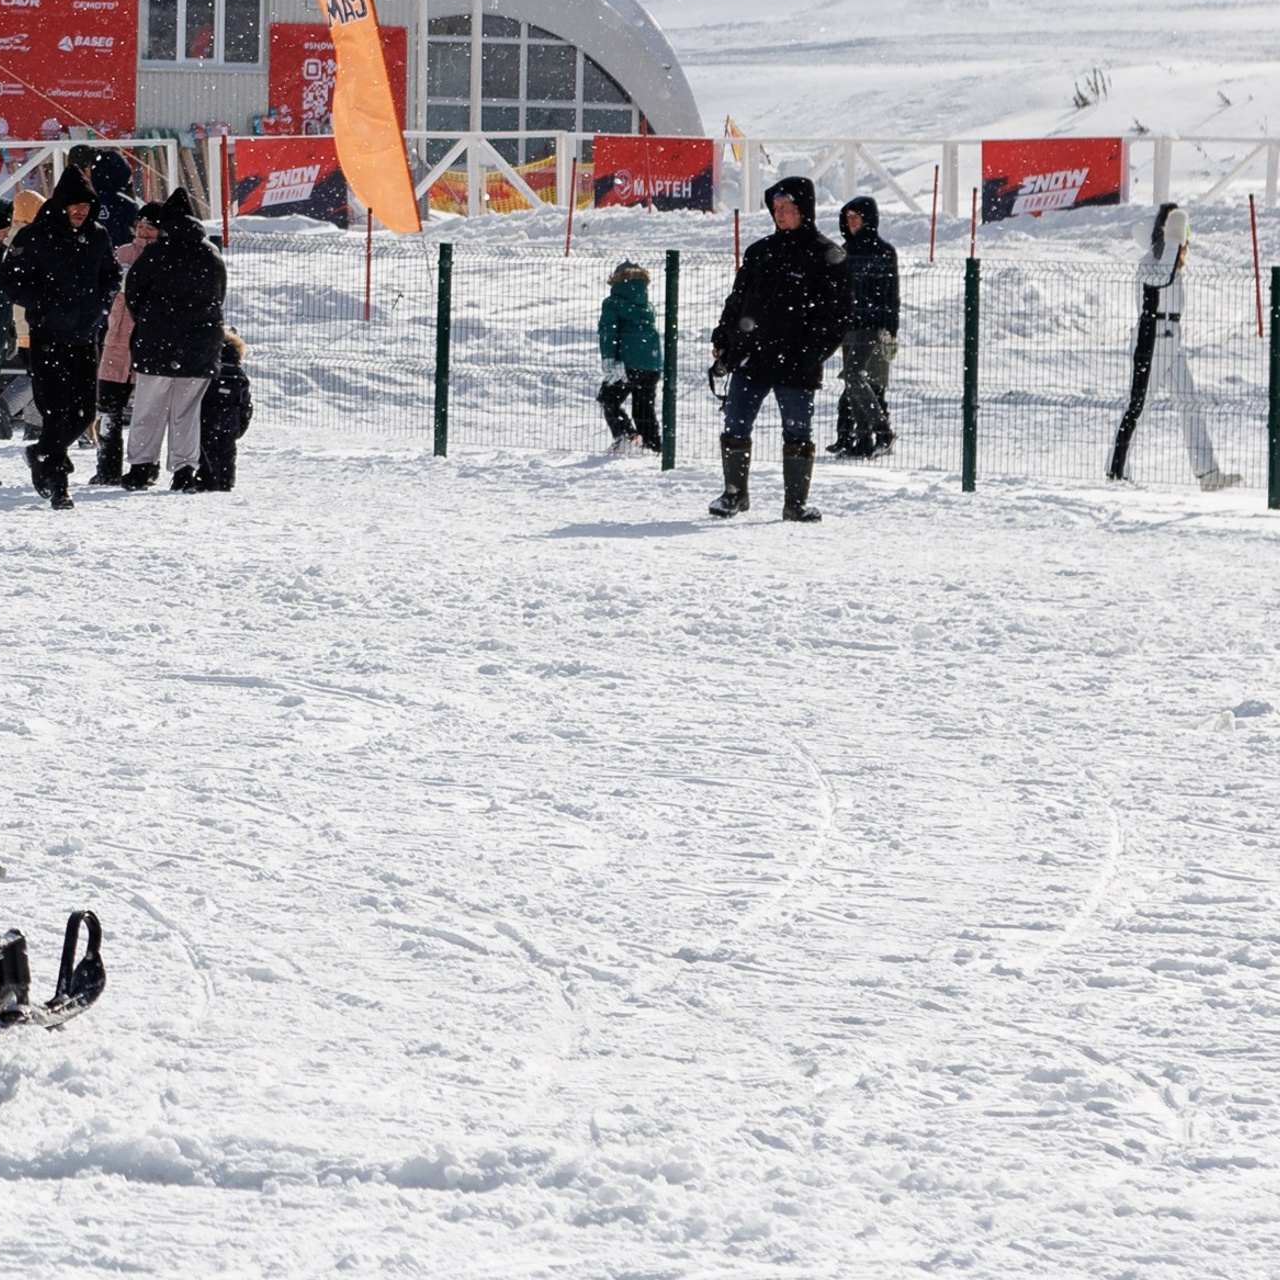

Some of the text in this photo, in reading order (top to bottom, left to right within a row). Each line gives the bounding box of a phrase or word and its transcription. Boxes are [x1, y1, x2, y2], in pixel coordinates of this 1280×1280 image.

[74, 36, 115, 48] BASEG
[266, 164, 321, 189] SNOW
[1017, 168, 1089, 195] SNOW
